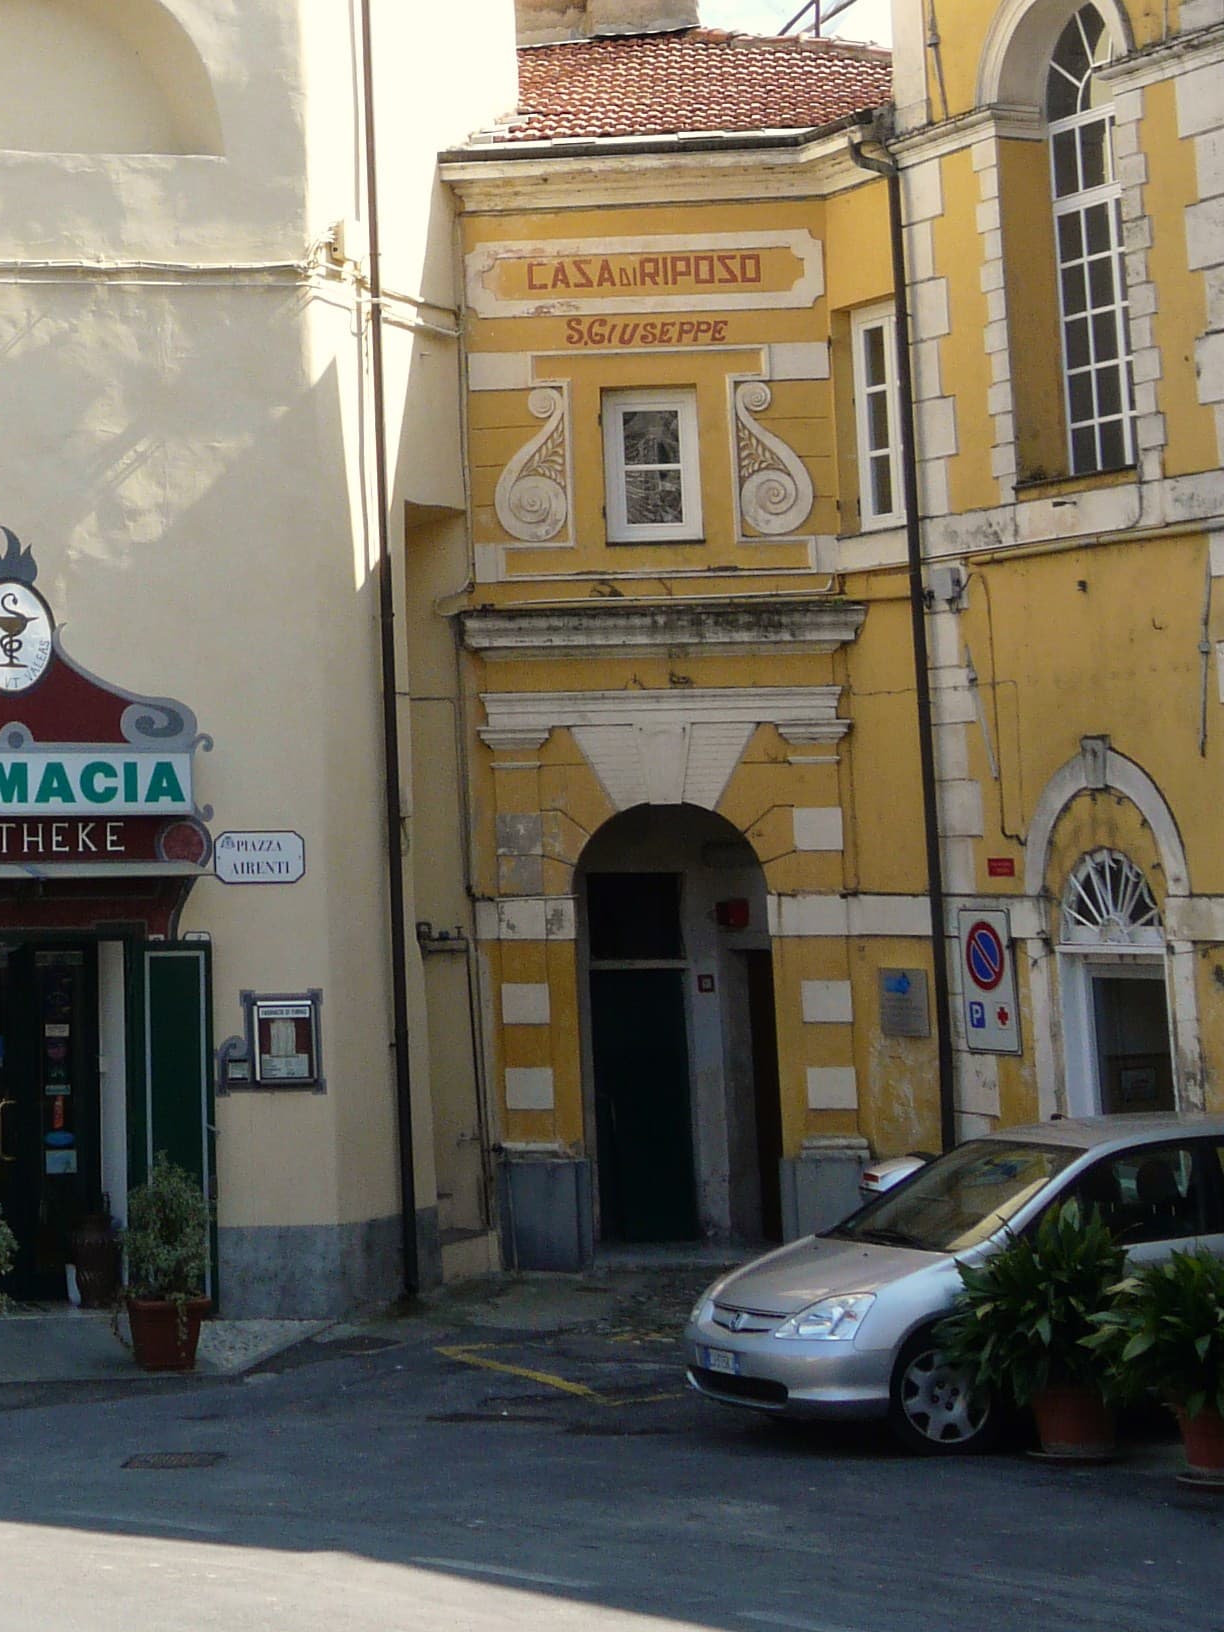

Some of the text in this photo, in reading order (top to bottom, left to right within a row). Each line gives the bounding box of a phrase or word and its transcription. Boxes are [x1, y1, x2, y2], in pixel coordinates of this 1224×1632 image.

[527, 253, 762, 290] CASA DI RIPOSO
[237, 839, 283, 852] PIAZZA
[232, 861, 290, 875] AIRENTI
